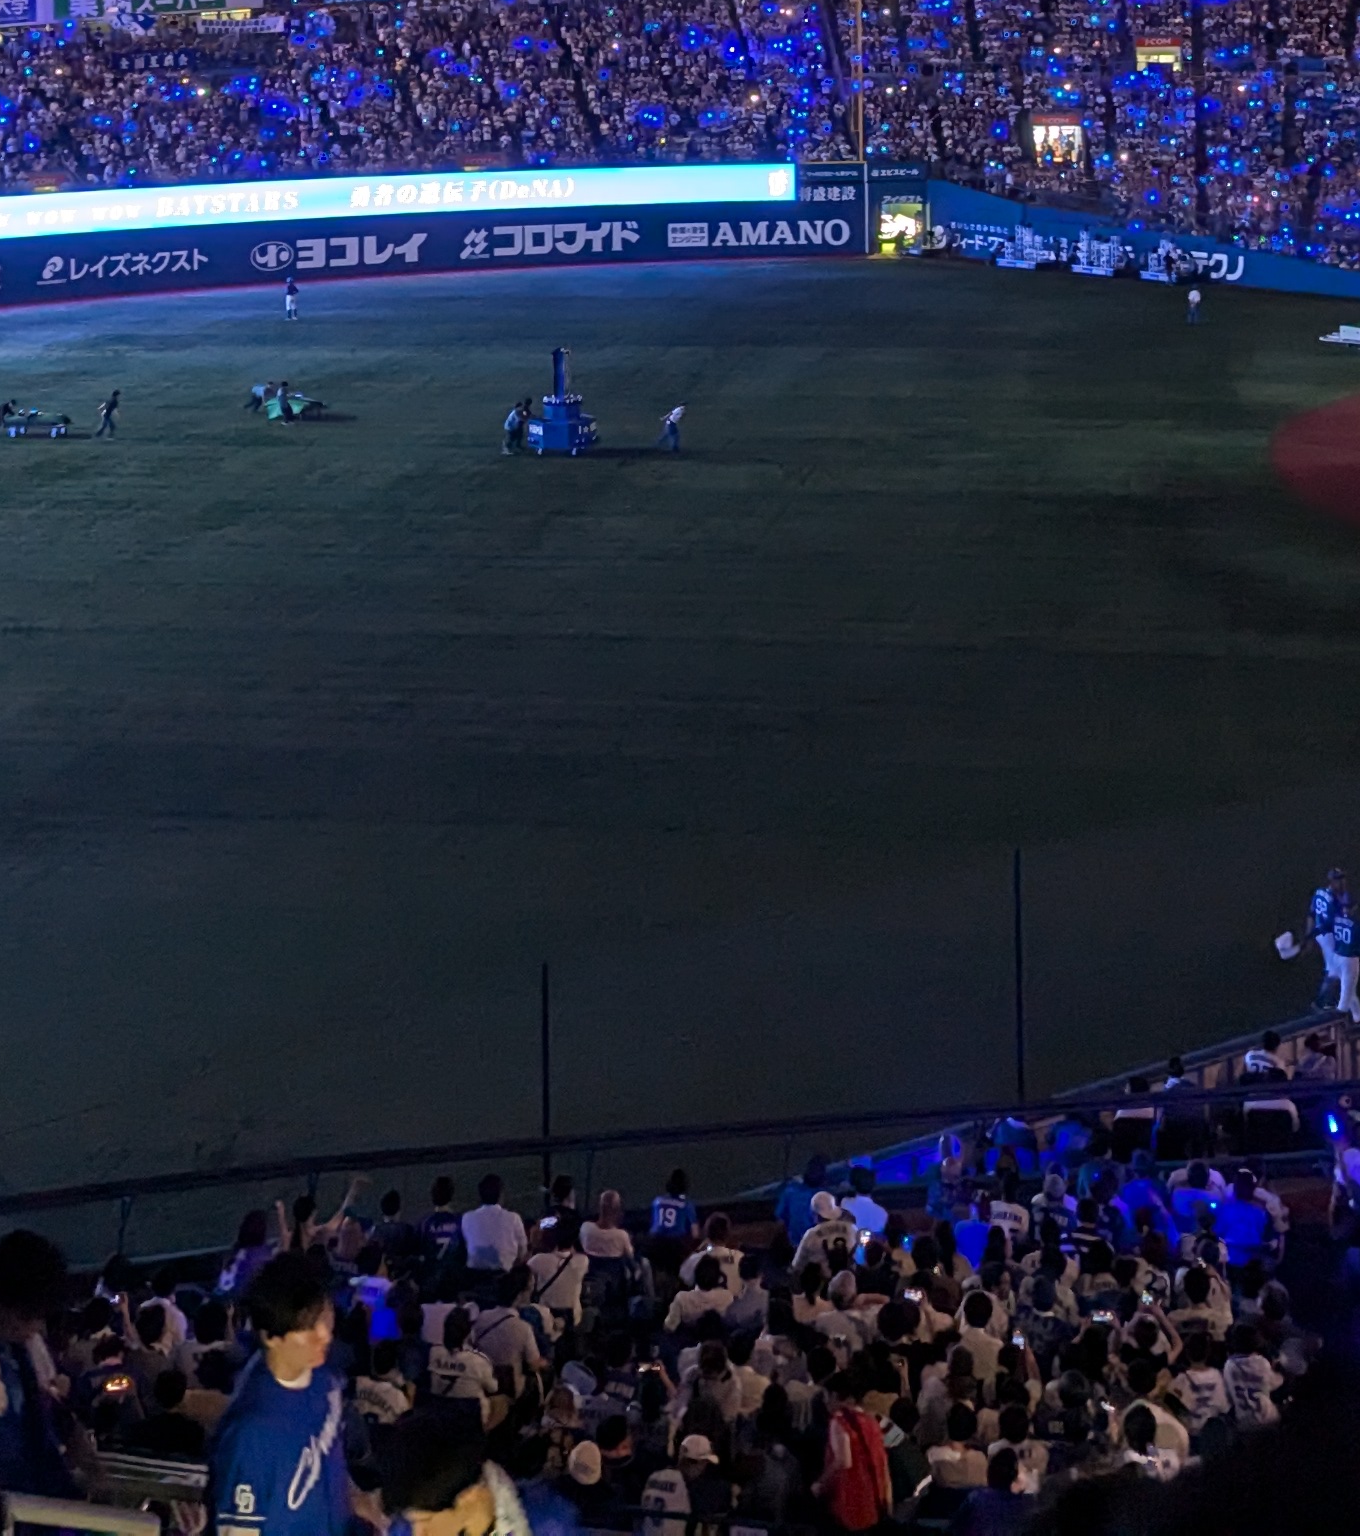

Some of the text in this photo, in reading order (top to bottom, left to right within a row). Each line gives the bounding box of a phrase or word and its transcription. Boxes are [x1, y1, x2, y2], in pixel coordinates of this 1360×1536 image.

[155, 190, 301, 219] BAYSTARS
[492, 220, 641, 256] コロワイド
[712, 219, 850, 246] AMANO
[69, 247, 209, 280] レイズネクスト
[295, 232, 429, 269] ヨコレイ
[1333, 925, 1352, 945] 50
[658, 1207, 678, 1229] 19
[435, 1237, 451, 1261] 7
[440, 1372, 459, 1396] 7
